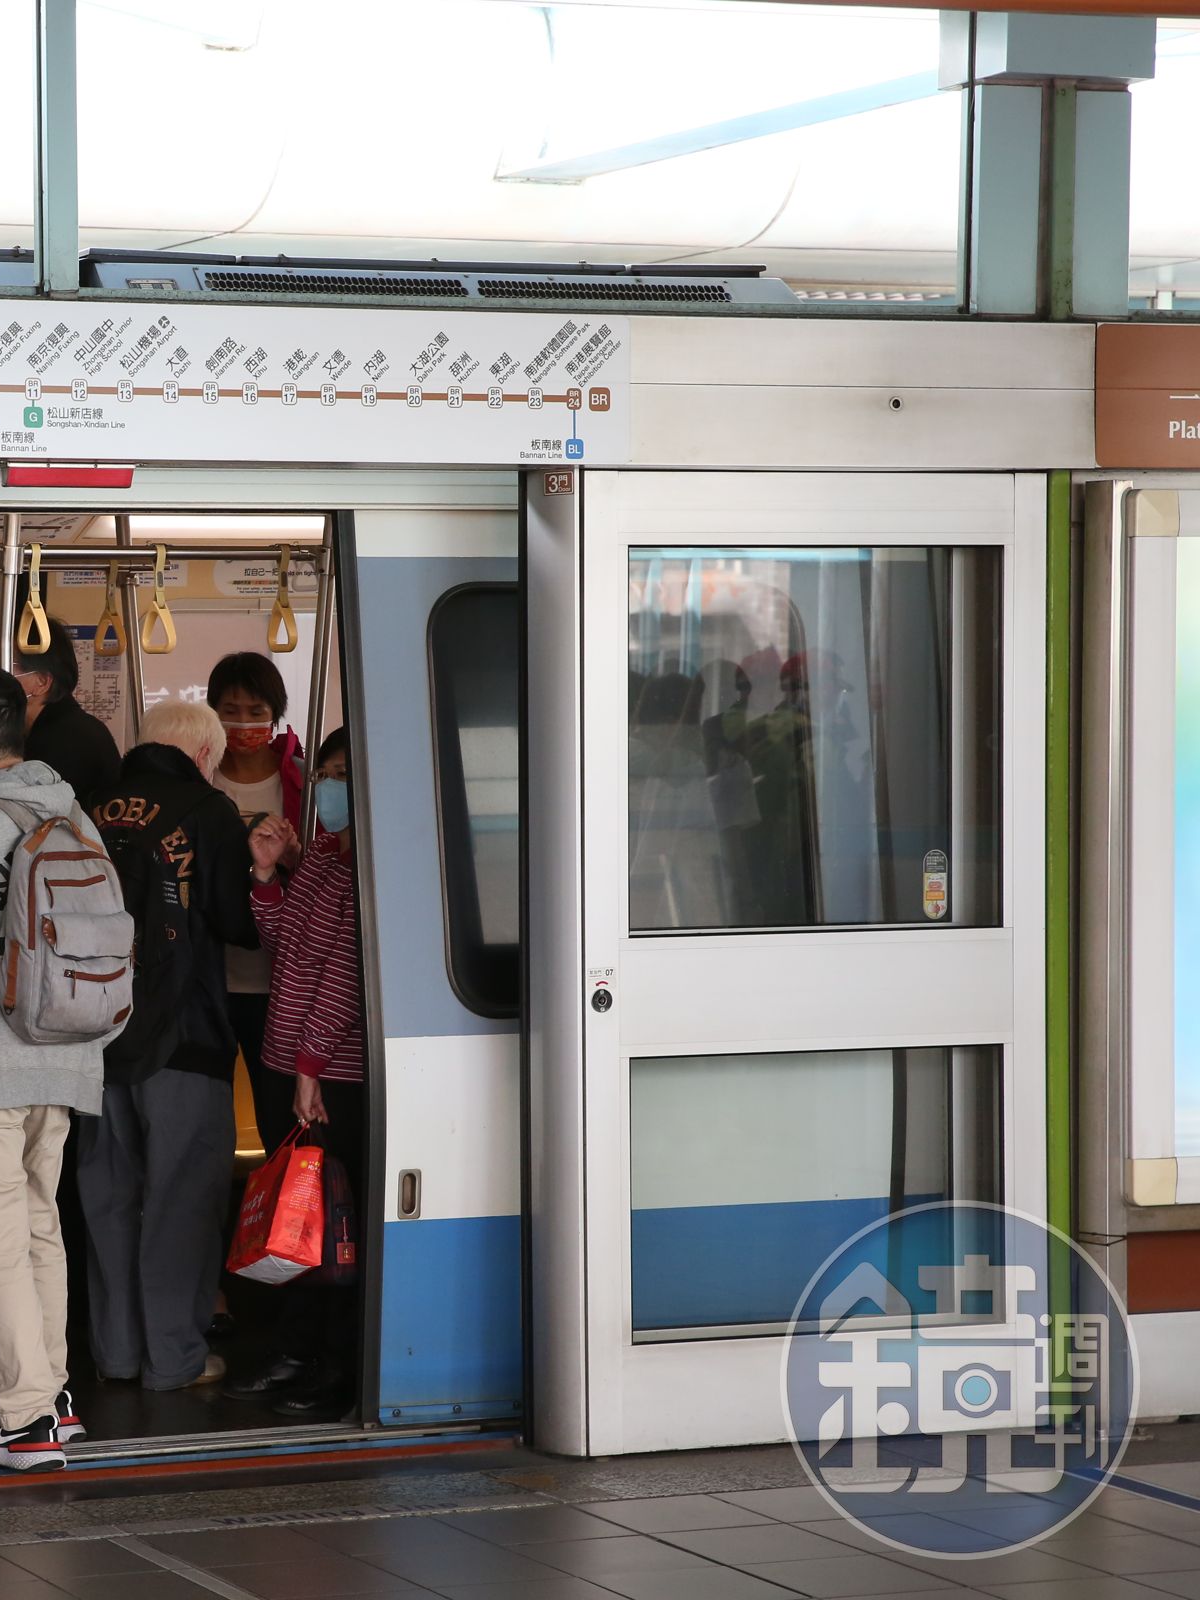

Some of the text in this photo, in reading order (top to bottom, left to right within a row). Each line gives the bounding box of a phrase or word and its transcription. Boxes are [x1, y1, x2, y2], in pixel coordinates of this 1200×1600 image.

[20, 320, 42, 343] Fuxing
[74, 318, 114, 363] 中山國中
[26, 322, 70, 368] 南京復興
[36, 331, 80, 376] Nanjing Fuxing
[83, 317, 133, 371] Zhongshan Junior
[120, 325, 161, 370] 松山機場
[128, 325, 178, 378] Songshan Airport
[204, 336, 238, 373] 劍南路
[409, 332, 449, 376] 大湖公園
[523, 320, 578, 379] 南港軟體園區
[532, 322, 591, 385] Nangang Software Park
[564, 324, 611, 376] 南港展覽館
[88, 340, 123, 377] High School
[165, 345, 189, 372] 大直
[174, 360, 192, 379] Dazhi
[215, 345, 248, 379] Jiannan Rd.
[243, 347, 268, 374] 西湖
[283, 348, 307, 374] 港墘
[292, 350, 320, 381] Gangqian
[322, 348, 346, 375] 文德
[417, 352, 447, 383] Dahu Park
[448, 351, 472, 378] 葫洲
[489, 352, 513, 377] 東湖
[574, 340, 614, 382] Taipei Nangang
[579, 340, 622, 388] Exhibition Center
[253, 365, 268, 380] Xihu
[331, 359, 353, 382] Wende
[372, 364, 390, 382] Neihu
[458, 360, 480, 384] Huzhou
[498, 361, 520, 385] Donghu
[28, 389, 38, 398] 11
[74, 390, 85, 399] 12
[120, 391, 131, 400] 13
[165, 392, 176, 400] 14
[205, 393, 216, 401] 15
[245, 394, 256, 402] 16
[284, 394, 295, 403] 17
[323, 395, 334, 404] 18
[364, 396, 375, 404] 19
[409, 396, 420, 405] 20
[450, 397, 460, 405] 21
[490, 397, 500, 405] 22
[530, 398, 540, 406] 23
[569, 399, 579, 407] 24
[592, 395, 607, 405] BR
[29, 413, 37, 421] G
[47, 408, 103, 419] 松山新店線
[47, 420, 108, 429] Songshan-Xindian
[1, 432, 35, 443] 板南線
[531, 440, 562, 450] 板南線
[568, 445, 581, 454] BL
